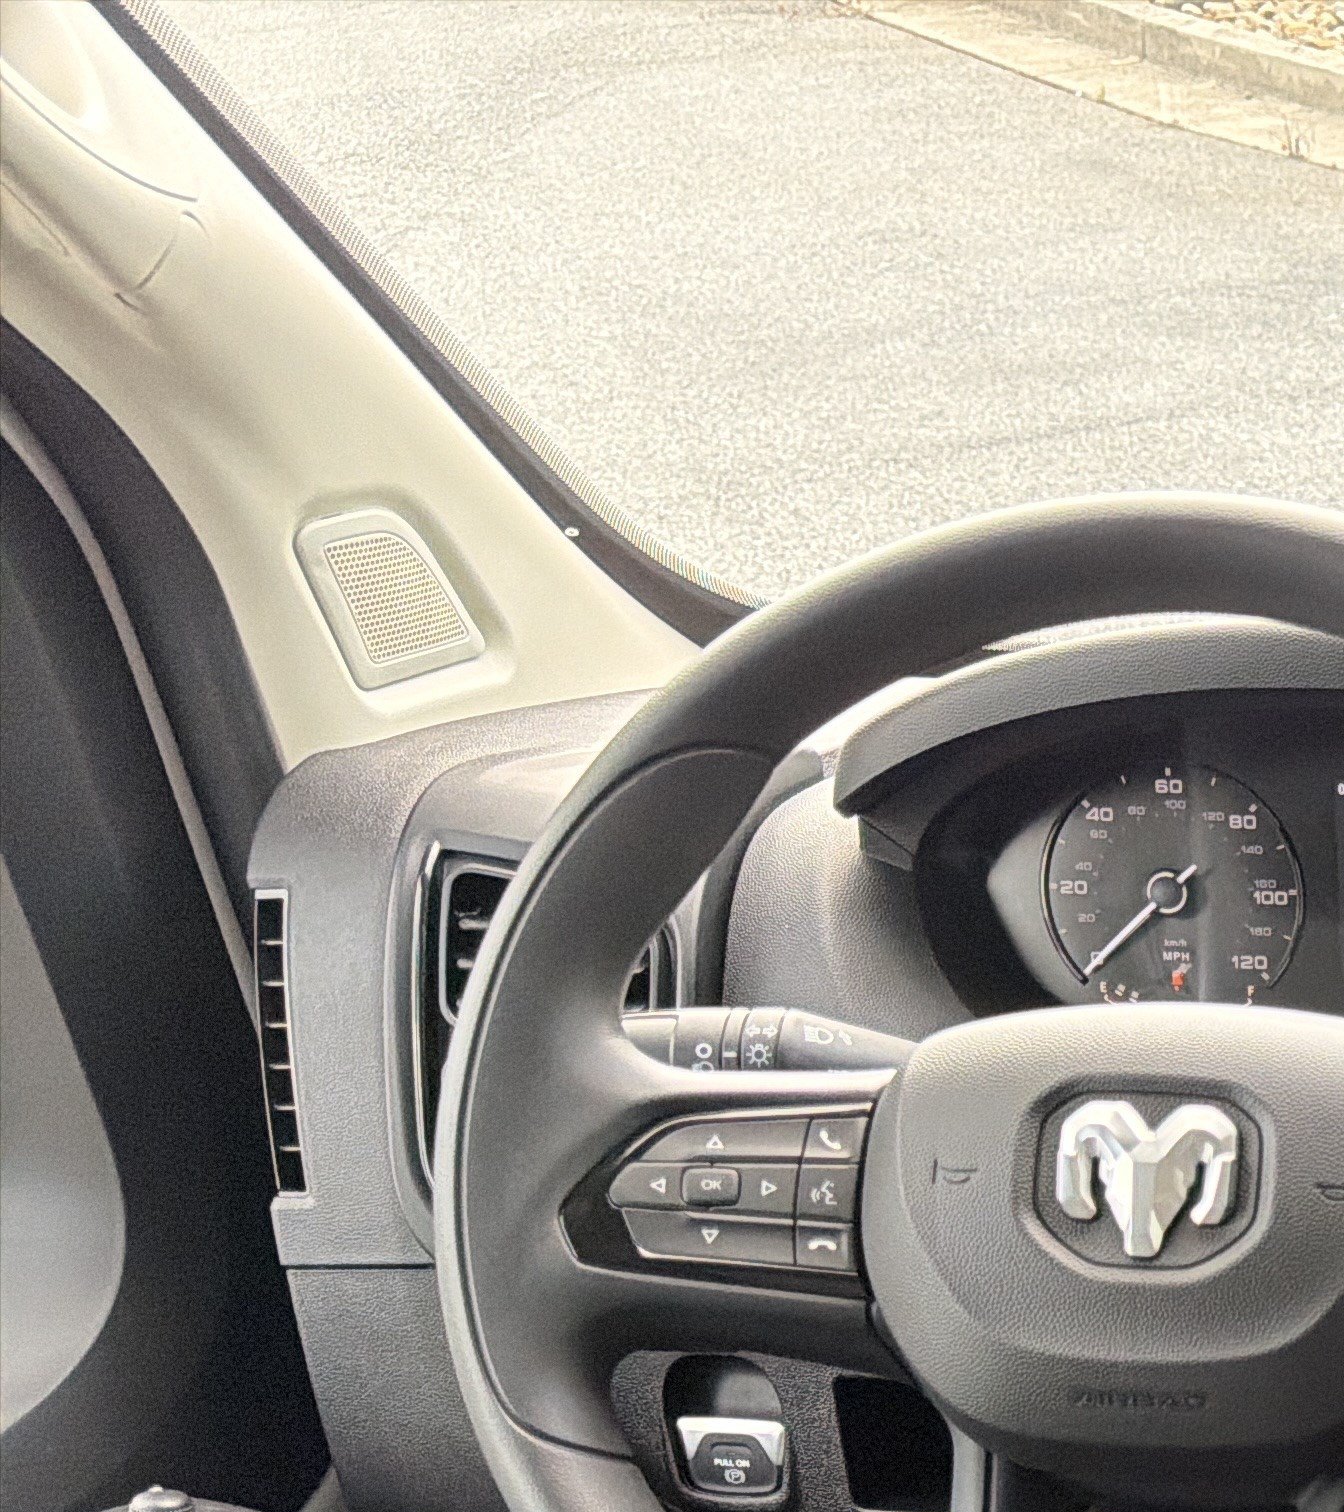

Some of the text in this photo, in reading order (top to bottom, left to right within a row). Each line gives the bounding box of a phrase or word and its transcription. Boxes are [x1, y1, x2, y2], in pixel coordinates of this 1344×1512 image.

[1155, 779, 1182, 794] 60
[1165, 800, 1186, 809] 100
[1086, 807, 1114, 821] 40
[1229, 815, 1256, 829] 80
[1241, 845, 1263, 854] 140
[1060, 880, 1087, 895] 20
[1253, 891, 1288, 905] 100
[1078, 914, 1095, 922] 20
[1164, 939, 1187, 947] km/h
[1163, 952, 1189, 961] MPH
[1231, 955, 1267, 969] 120
[1100, 982, 1107, 992] E
[1247, 986, 1254, 996] F
[701, 1179, 722, 1191] OK
